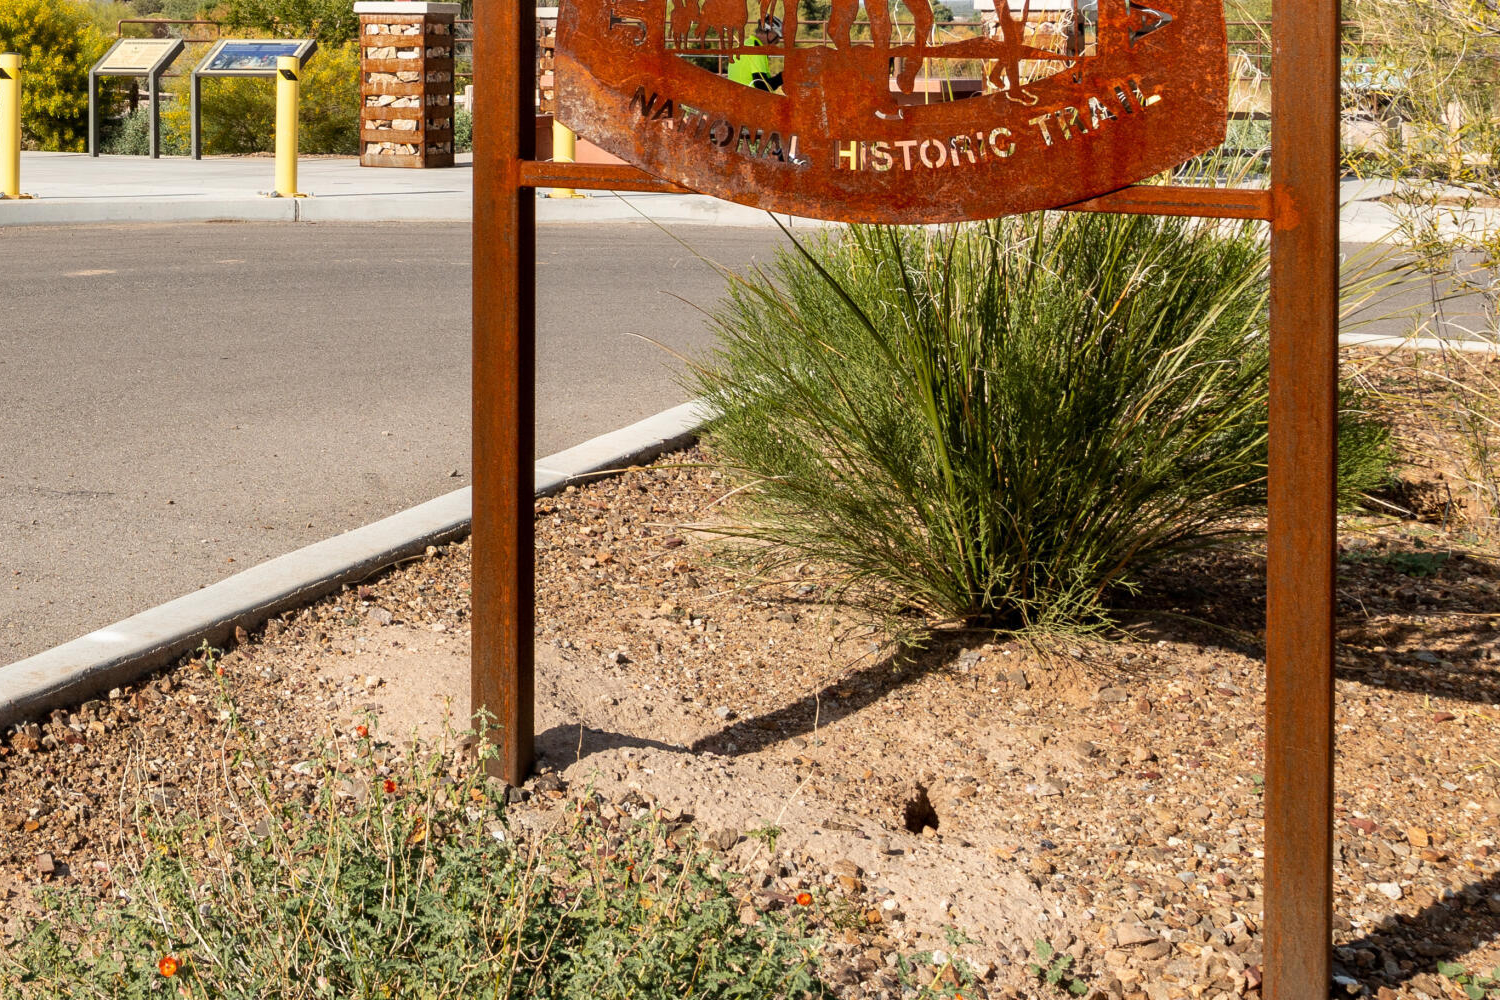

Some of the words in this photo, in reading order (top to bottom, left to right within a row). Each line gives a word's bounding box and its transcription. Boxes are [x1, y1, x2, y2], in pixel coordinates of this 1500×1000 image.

[629, 85, 810, 167] NATIONAL
[833, 126, 1016, 172] HISTORIC
[1029, 78, 1163, 147] TRAIL
